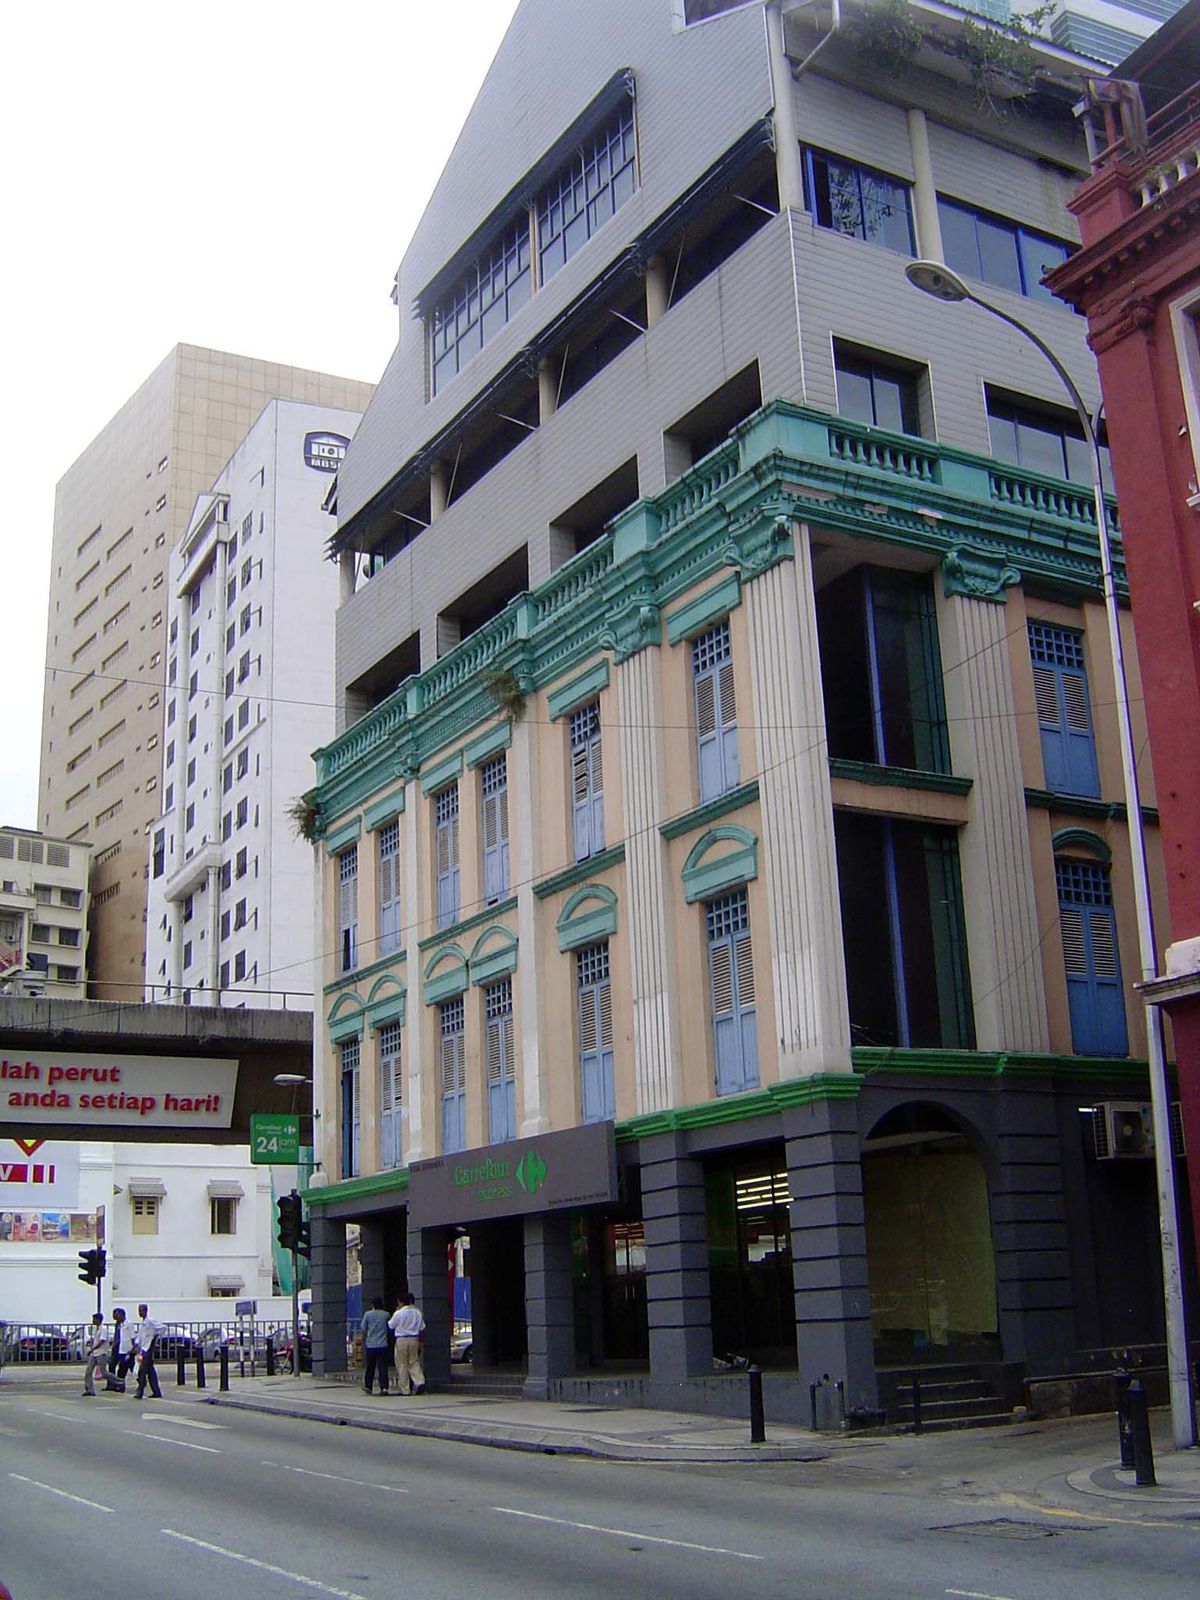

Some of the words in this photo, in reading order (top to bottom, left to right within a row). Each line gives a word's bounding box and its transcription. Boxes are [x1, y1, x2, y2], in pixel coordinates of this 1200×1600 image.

[1, 1060, 40, 1079] lah
[48, 1065, 120, 1085] perut
[8, 1090, 70, 1108] anda
[79, 1092, 156, 1115] setiap
[164, 1094, 220, 1112] hari!
[256, 1136, 278, 1153] 24
[454, 1159, 511, 1185] Carrefour
